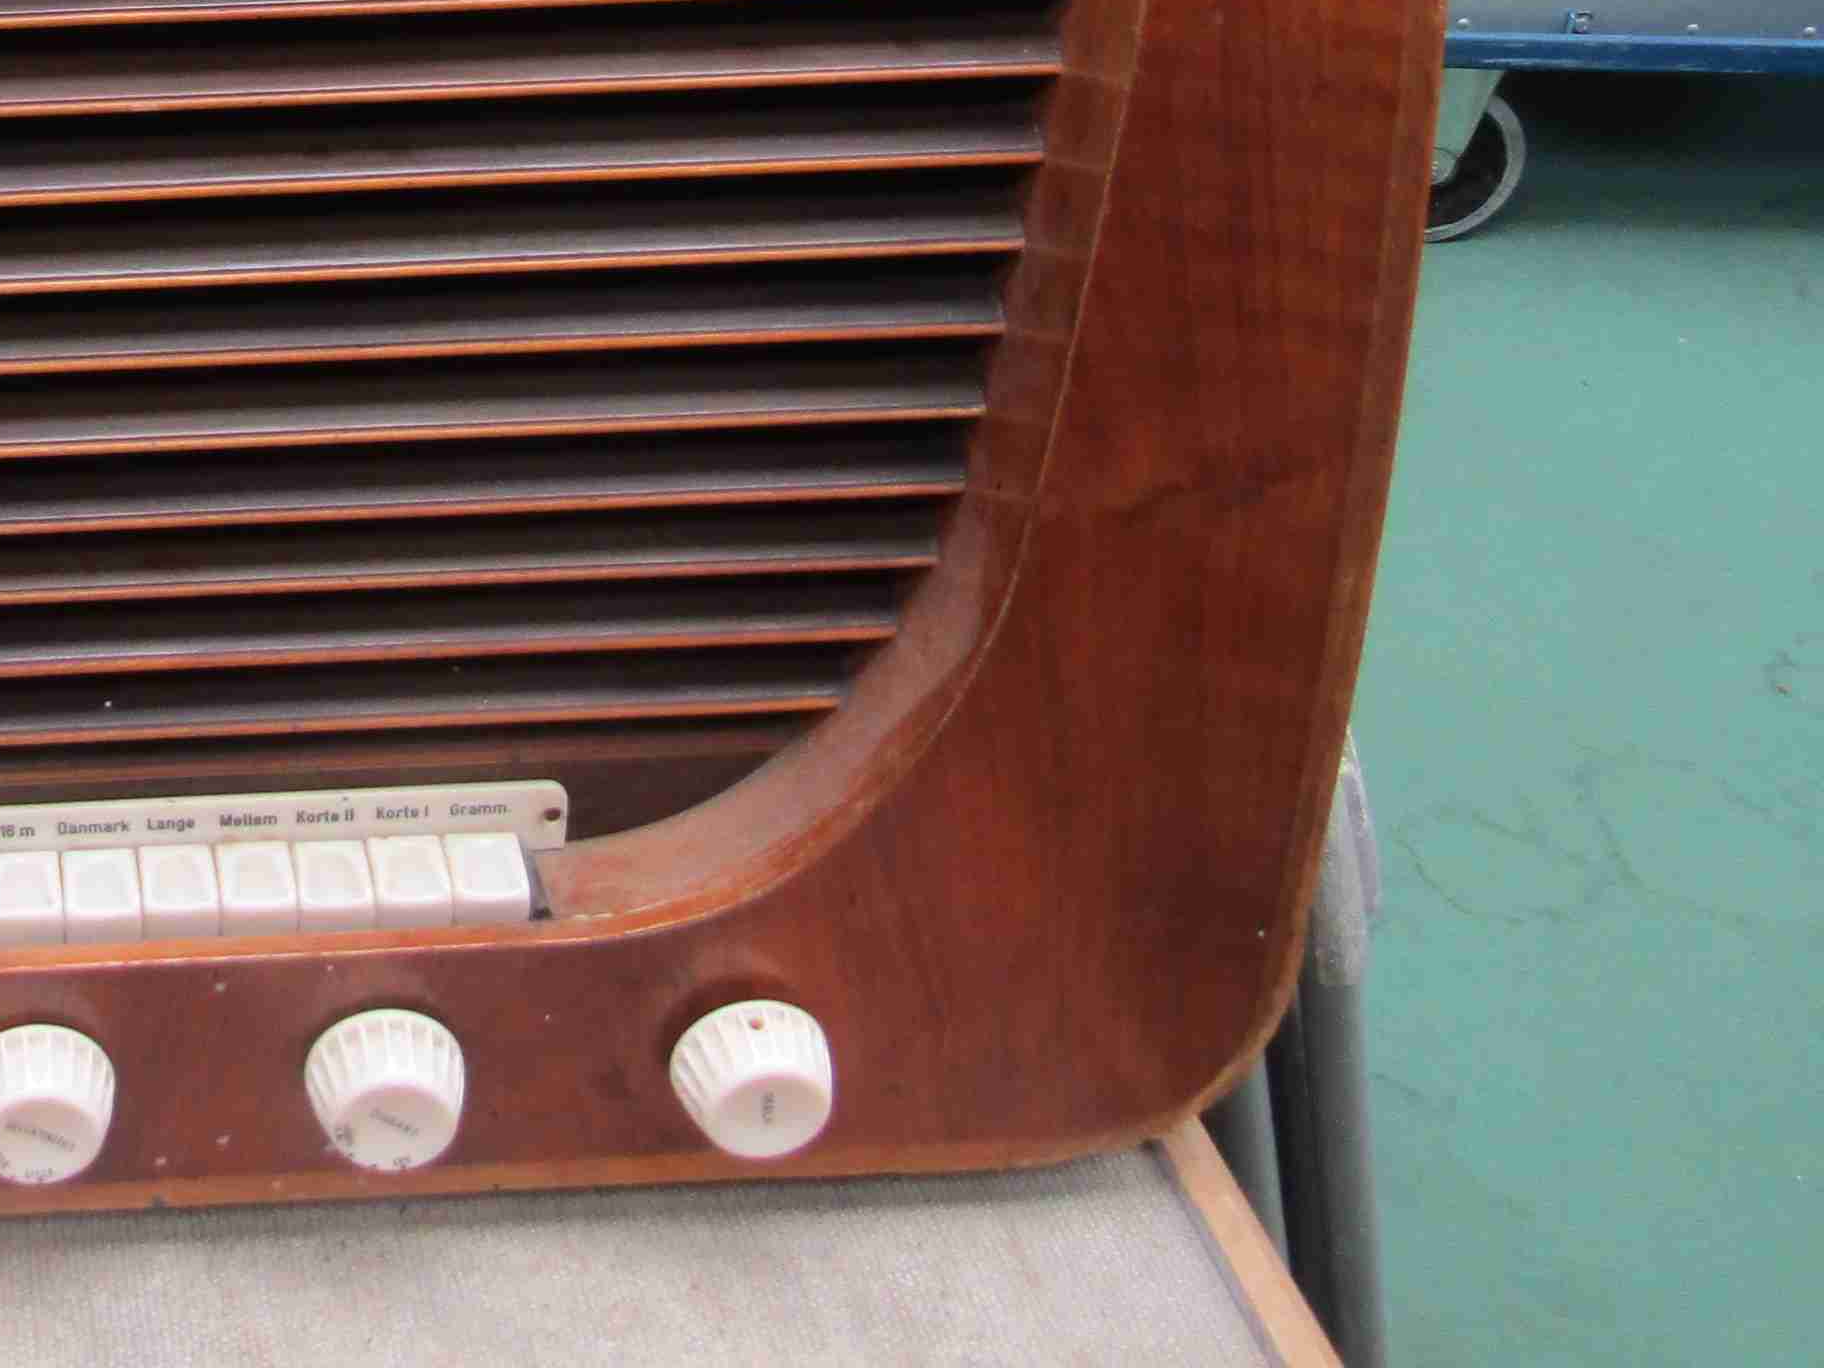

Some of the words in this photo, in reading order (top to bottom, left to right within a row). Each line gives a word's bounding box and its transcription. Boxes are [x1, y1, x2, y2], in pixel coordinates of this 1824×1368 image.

[20, 824, 35, 837] m
[56, 819, 131, 836] Danmark
[146, 815, 196, 833] Lange
[219, 810, 279, 828] Mellem
[295, 807, 340, 825] Korte
[375, 805, 418, 821] Korte
[449, 800, 512, 818] Gramm.
